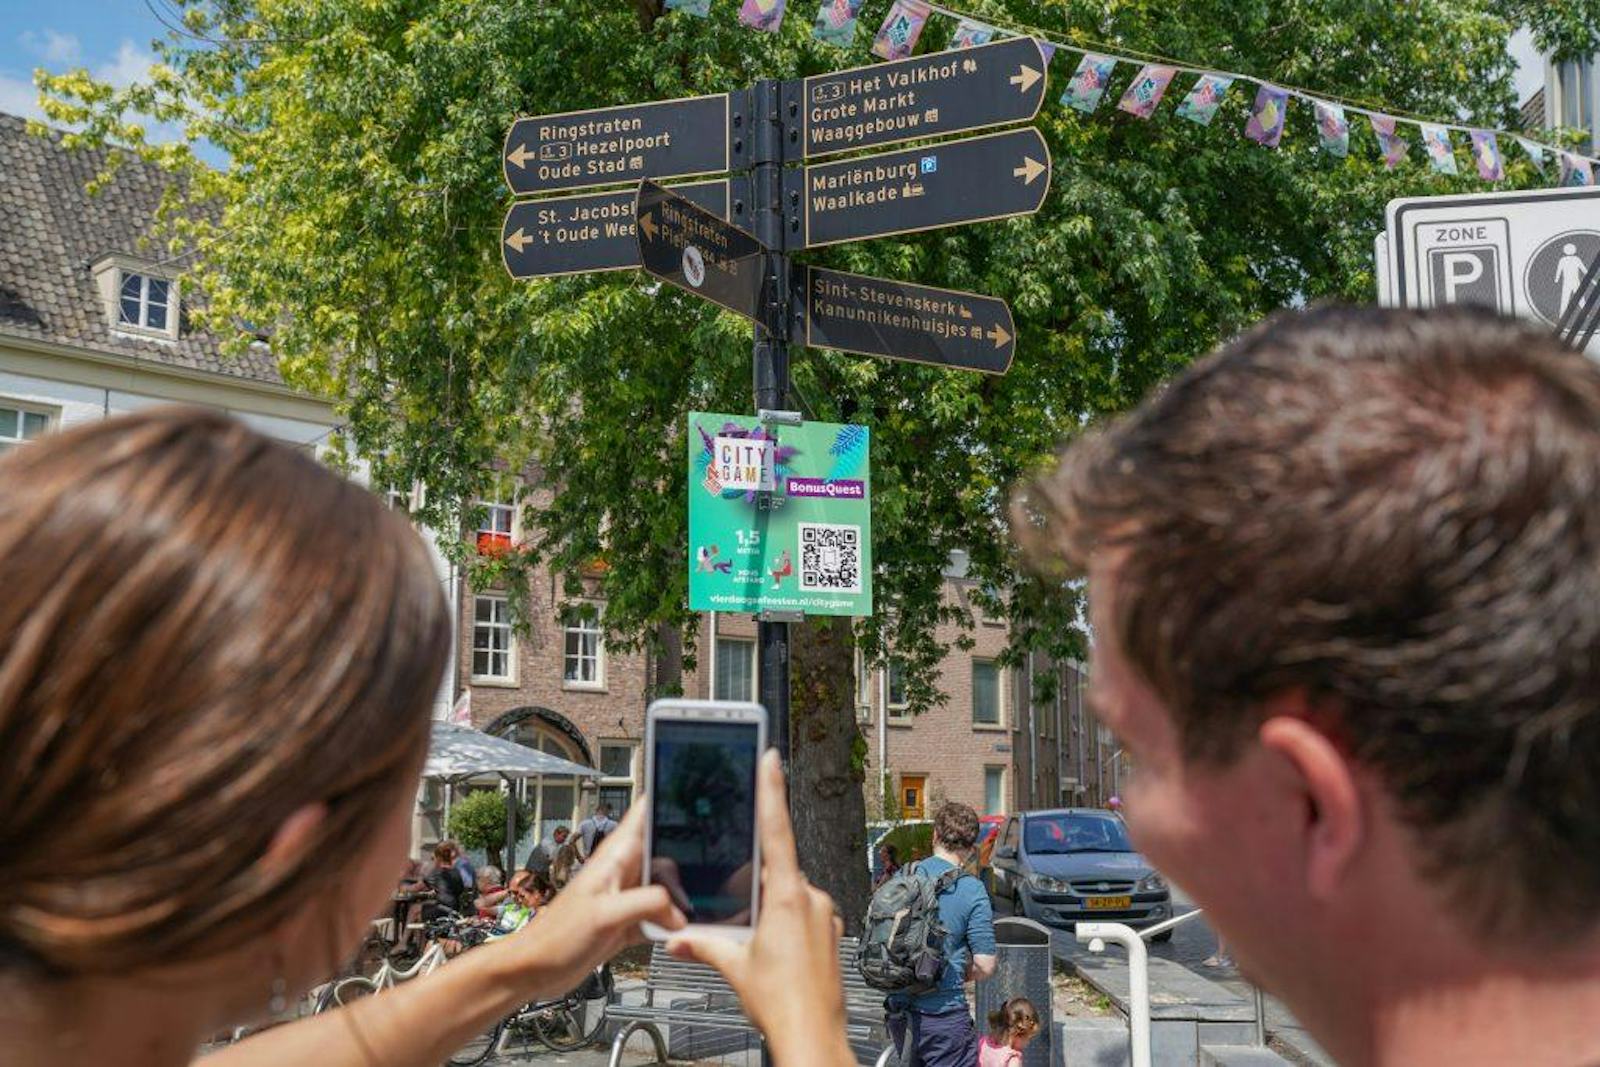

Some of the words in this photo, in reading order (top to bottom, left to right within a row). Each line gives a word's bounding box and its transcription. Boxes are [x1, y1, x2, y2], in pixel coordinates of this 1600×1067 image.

[850, 76, 881, 95] Het
[887, 61, 957, 87] Valkhof
[811, 103, 857, 123] Grote
[864, 91, 916, 113] Markt
[539, 118, 642, 142] Ringstraten
[811, 113, 920, 143] Waaggebouw
[576, 132, 671, 156] Hezelpoort
[539, 163, 581, 180] Oude
[587, 157, 625, 175] Stad
[812, 162, 918, 192] Mariënburg
[812, 186, 898, 212] Waalkade
[538, 209, 562, 225] St.
[661, 200, 728, 248] Ringstraten
[538, 230, 550, 244] 't
[556, 225, 599, 243] Oude
[605, 222, 637, 238] Wee
[1436, 227, 1487, 242] ZONE
[1443, 253, 1484, 304] P
[814, 299, 967, 338] Kanunnikenhuisjes
[722, 445, 767, 465] CITY
[722, 465, 767, 483] GAME
[789, 482, 862, 495] BonusQuest
[735, 529, 760, 546] 1,5
